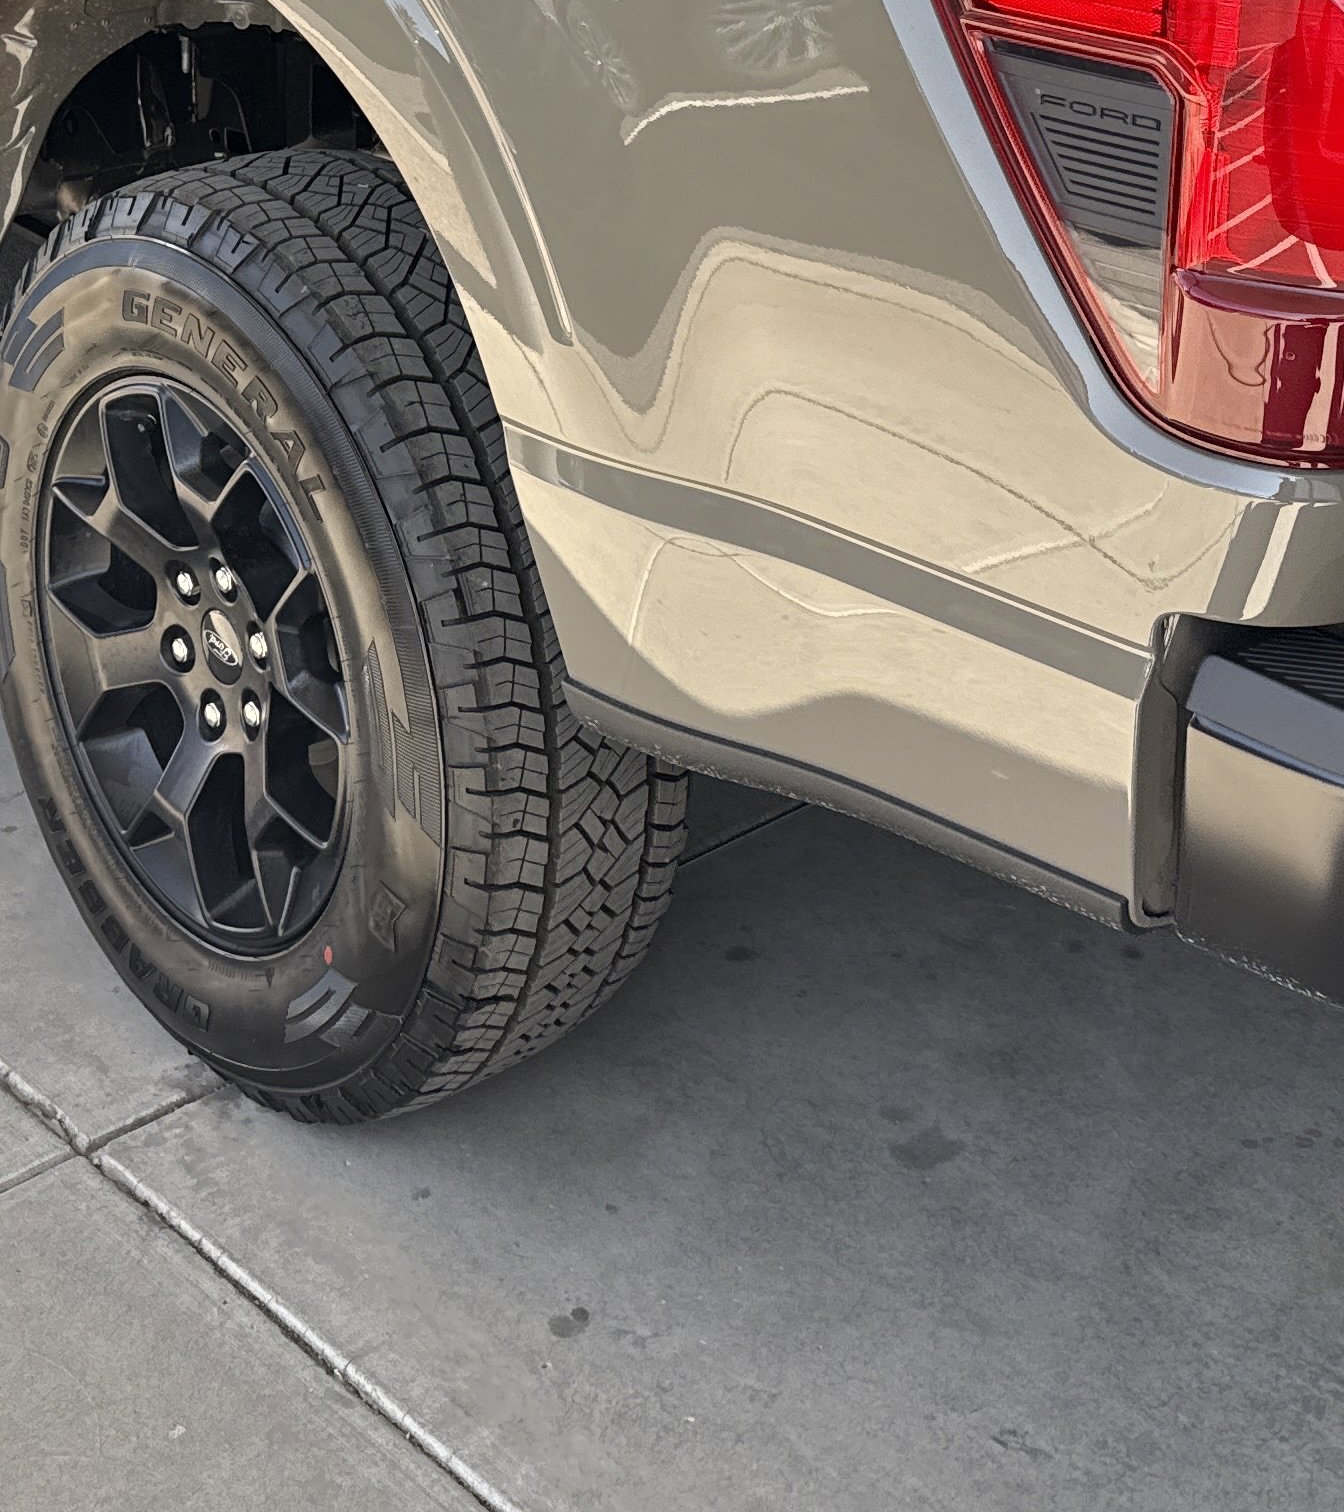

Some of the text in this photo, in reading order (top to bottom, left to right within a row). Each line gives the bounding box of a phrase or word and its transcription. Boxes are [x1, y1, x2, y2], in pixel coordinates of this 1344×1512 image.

[1040, 93, 1162, 132] FORD
[122, 289, 327, 524] GENERAL
[208, 633, 233, 662] Ford
[38, 797, 211, 1032] GRABBER
